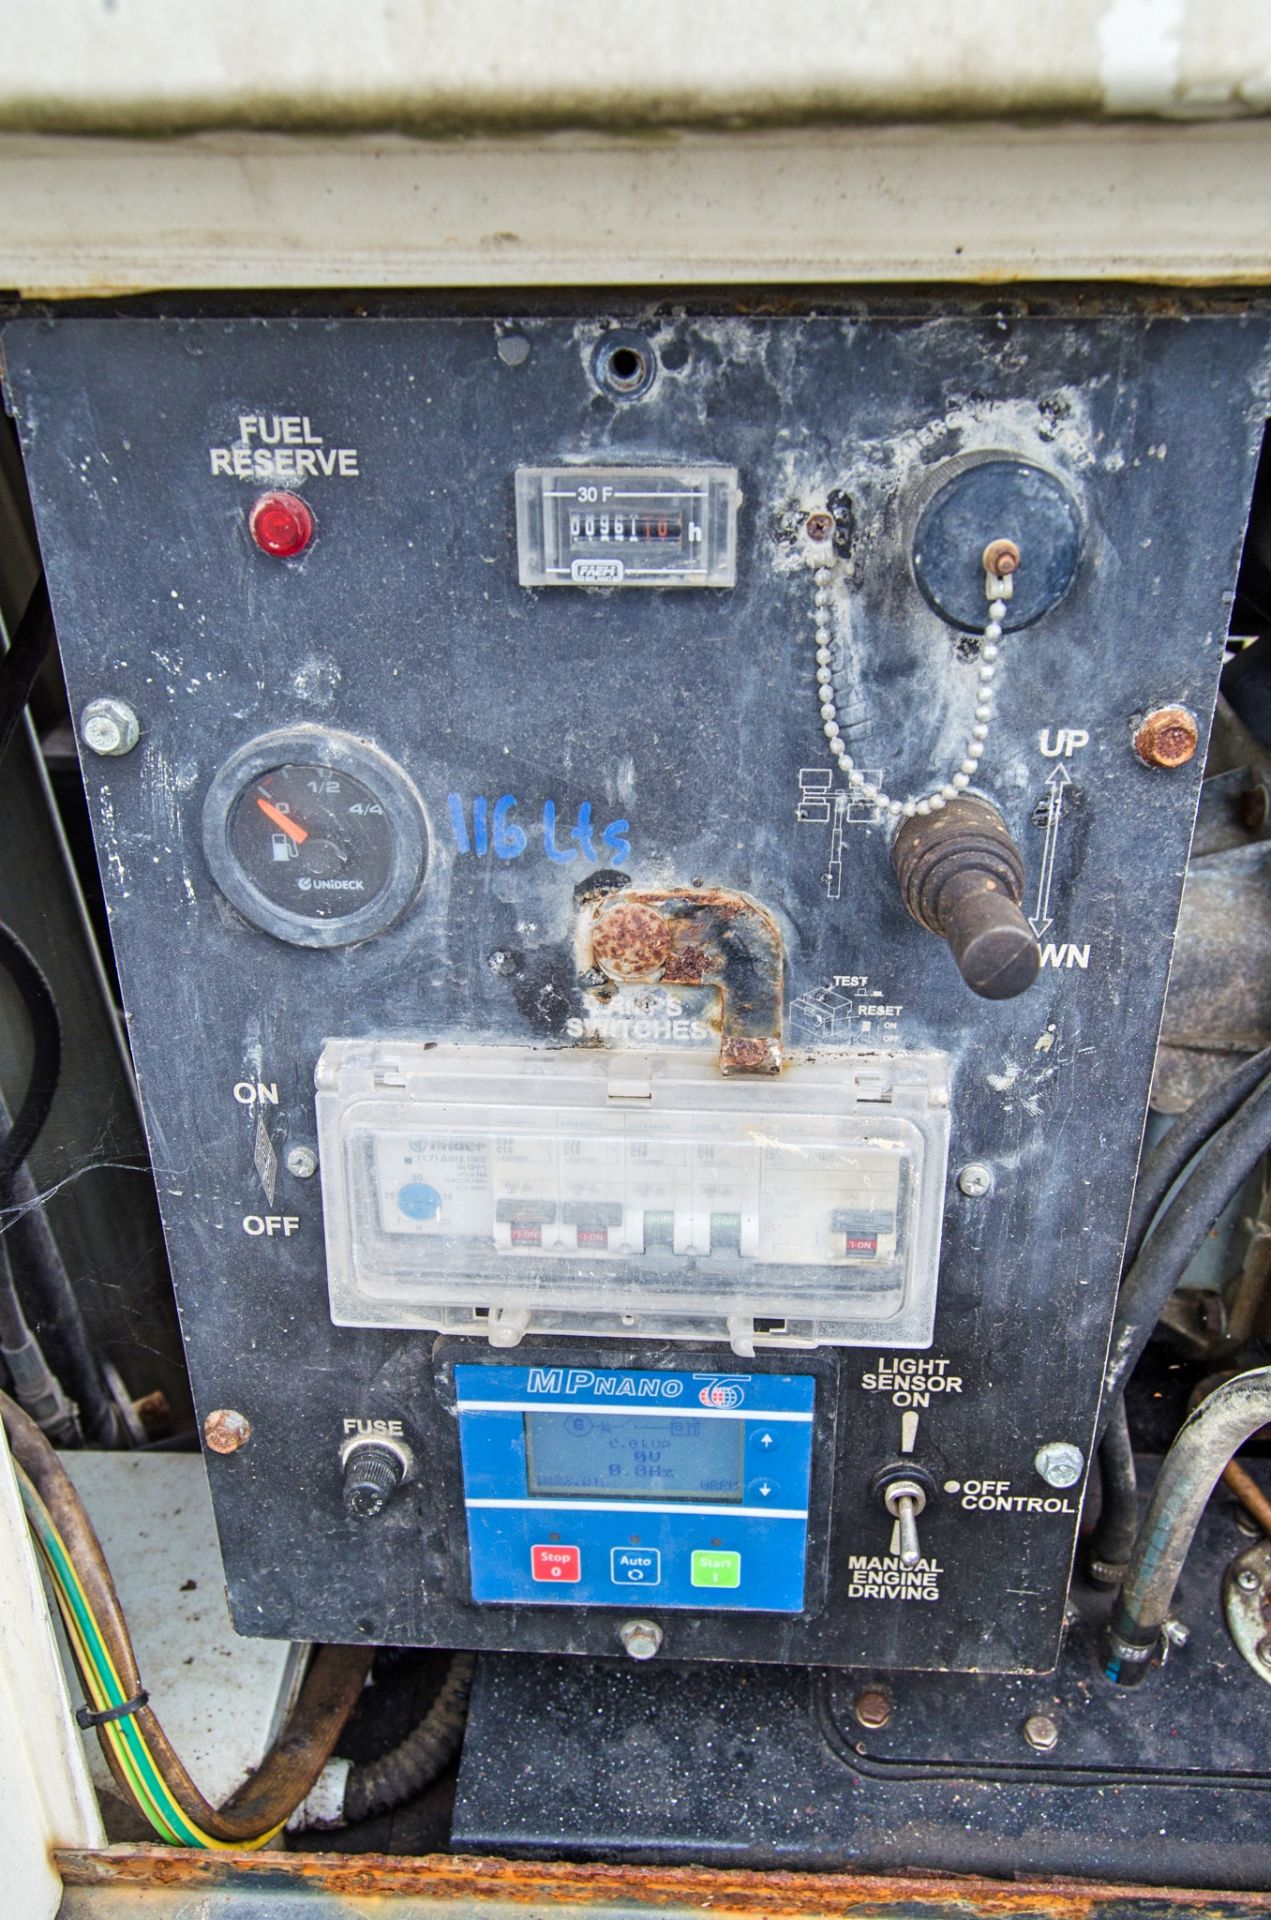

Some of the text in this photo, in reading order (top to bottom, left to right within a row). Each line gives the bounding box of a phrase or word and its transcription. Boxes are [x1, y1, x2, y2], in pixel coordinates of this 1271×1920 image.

[238, 416, 324, 444] FUEL
[210, 448, 360, 477] RESERVE
[577, 487, 613, 502] 30 F
[688, 522, 702, 541] h
[1040, 729, 1090, 758] UP
[307, 781, 341, 794] 1/2
[349, 803, 384, 816] 4/4
[447, 792, 527, 860] 116
[1039, 943, 1091, 969] WN
[833, 975, 869, 987] TEST
[858, 1005, 903, 1016] RESET
[233, 1083, 279, 1105] ON
[242, 1215, 300, 1236] OFF
[878, 1357, 950, 1376] LIGHT
[861, 1374, 963, 1393] SENSOR
[892, 1391, 930, 1408] ON
[343, 1418, 404, 1437] FUSE
[963, 1481, 1010, 1496] OFF
[961, 1496, 1075, 1513] CONTROL
[541, 1552, 571, 1564] Stop
[620, 1555, 652, 1567] Auto
[701, 1558, 732, 1569] Start
[853, 1571, 937, 1586] ENGINE
[848, 1584, 940, 1600] DRIVING
